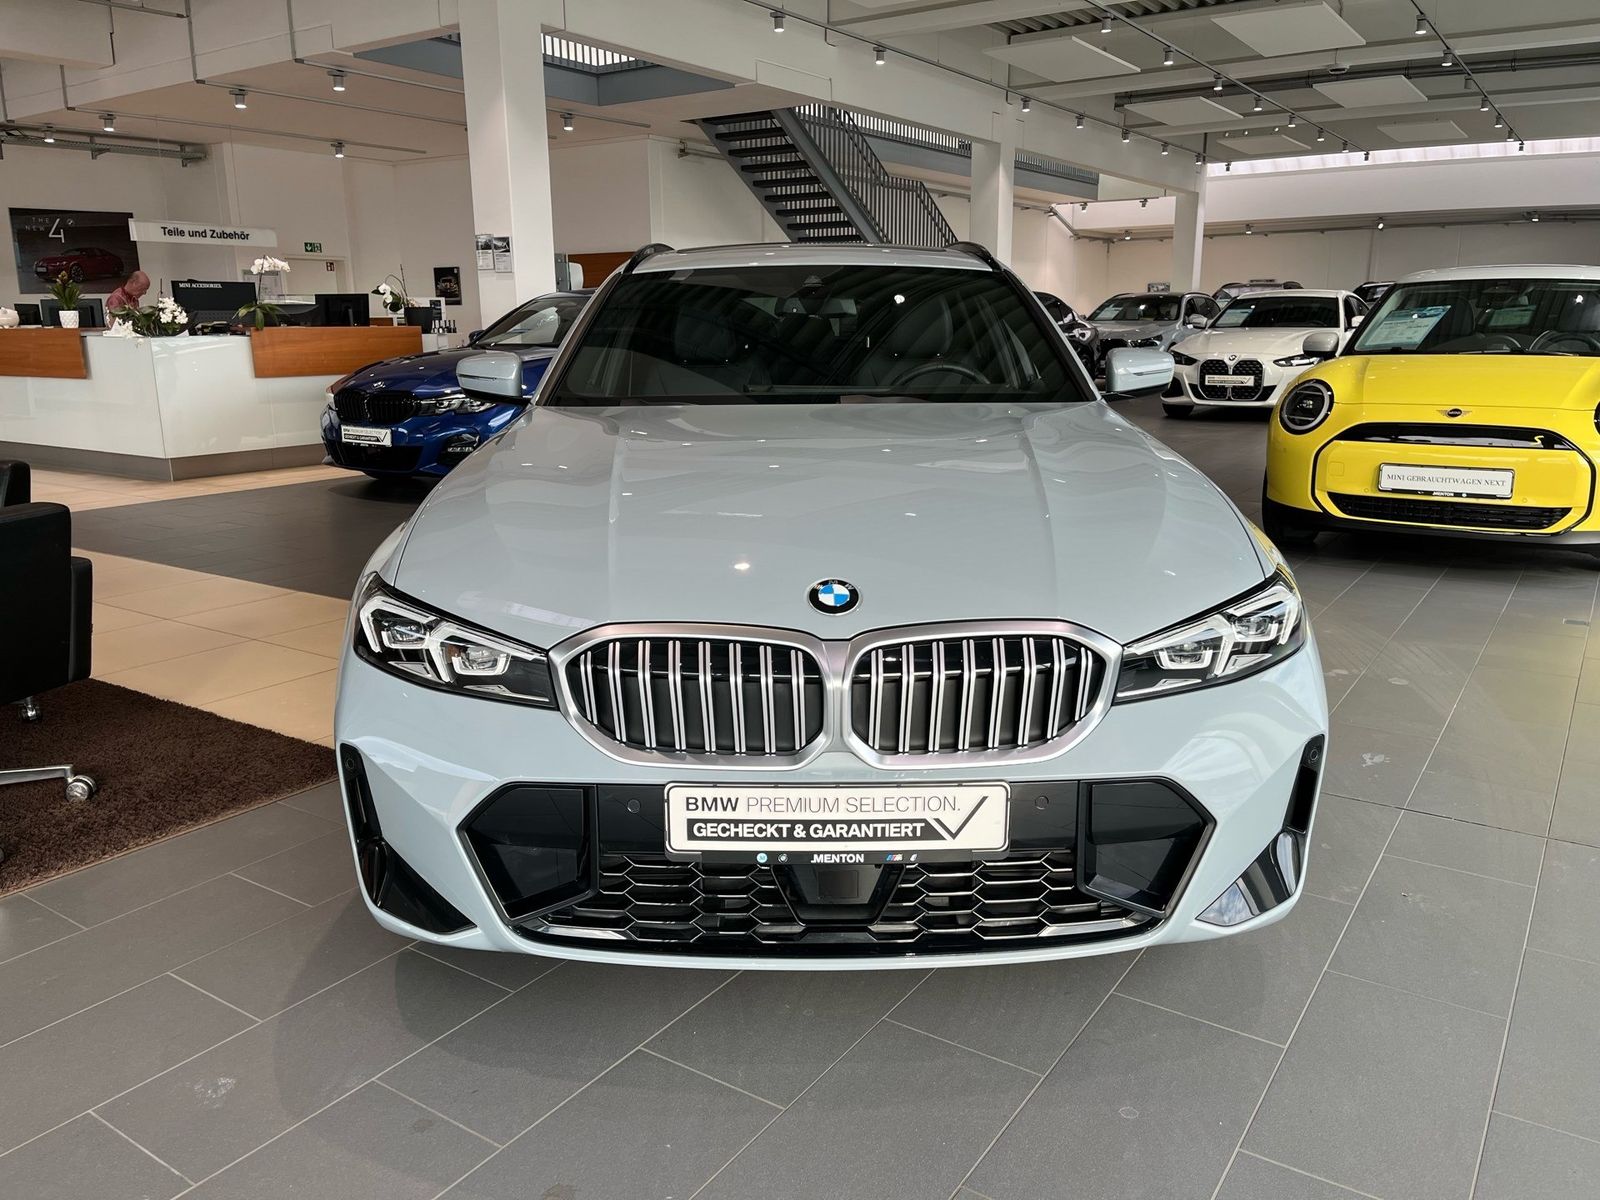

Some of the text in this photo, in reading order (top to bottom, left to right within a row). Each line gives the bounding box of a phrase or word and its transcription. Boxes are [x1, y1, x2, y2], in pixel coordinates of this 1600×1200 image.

[49, 218, 65, 243] 4
[161, 226, 250, 240] Teile und Zubehör
[1387, 473, 1506, 487] MINI GEBRAUCHTWAGEN NEXT
[685, 795, 961, 813] BMW PREMIUM SELECTION.
[693, 822, 925, 838] GECHECKT & GARANTIERT
[811, 853, 864, 863] MENTON
